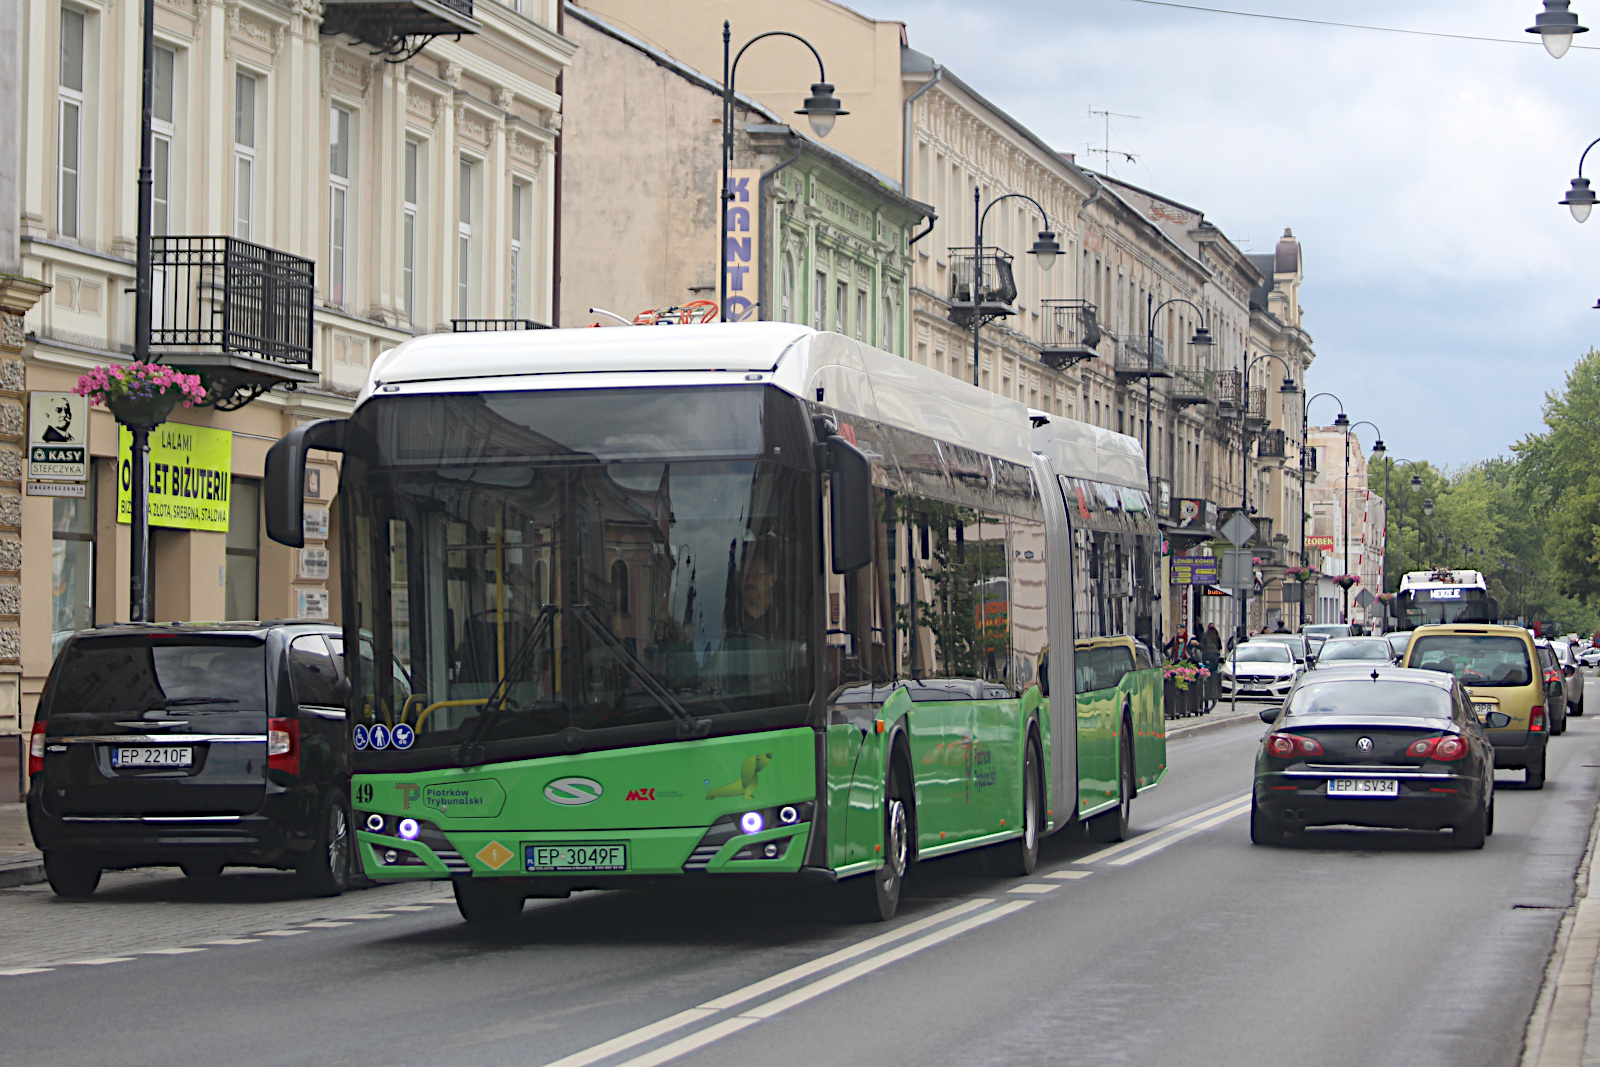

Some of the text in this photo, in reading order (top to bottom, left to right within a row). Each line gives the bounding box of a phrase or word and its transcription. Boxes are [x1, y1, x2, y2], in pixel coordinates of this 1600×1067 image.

[161, 430, 192, 452] LALAMI
[48, 450, 82, 461] KASY
[33, 464, 82, 474] STEFCZYKA
[122, 454, 228, 502] OLET BIŻUTERII
[201, 507, 227, 523] STALOWA
[1409, 589, 1416, 600] 7
[121, 749, 188, 763] EP 2210F
[426, 788, 469, 797] Piotrków
[1363, 780, 1393, 792] SV34
[356, 783, 373, 804] 49
[625, 788, 656, 801] MZK
[426, 796, 483, 806] Trybunalski
[538, 847, 620, 865] EP 3049F
